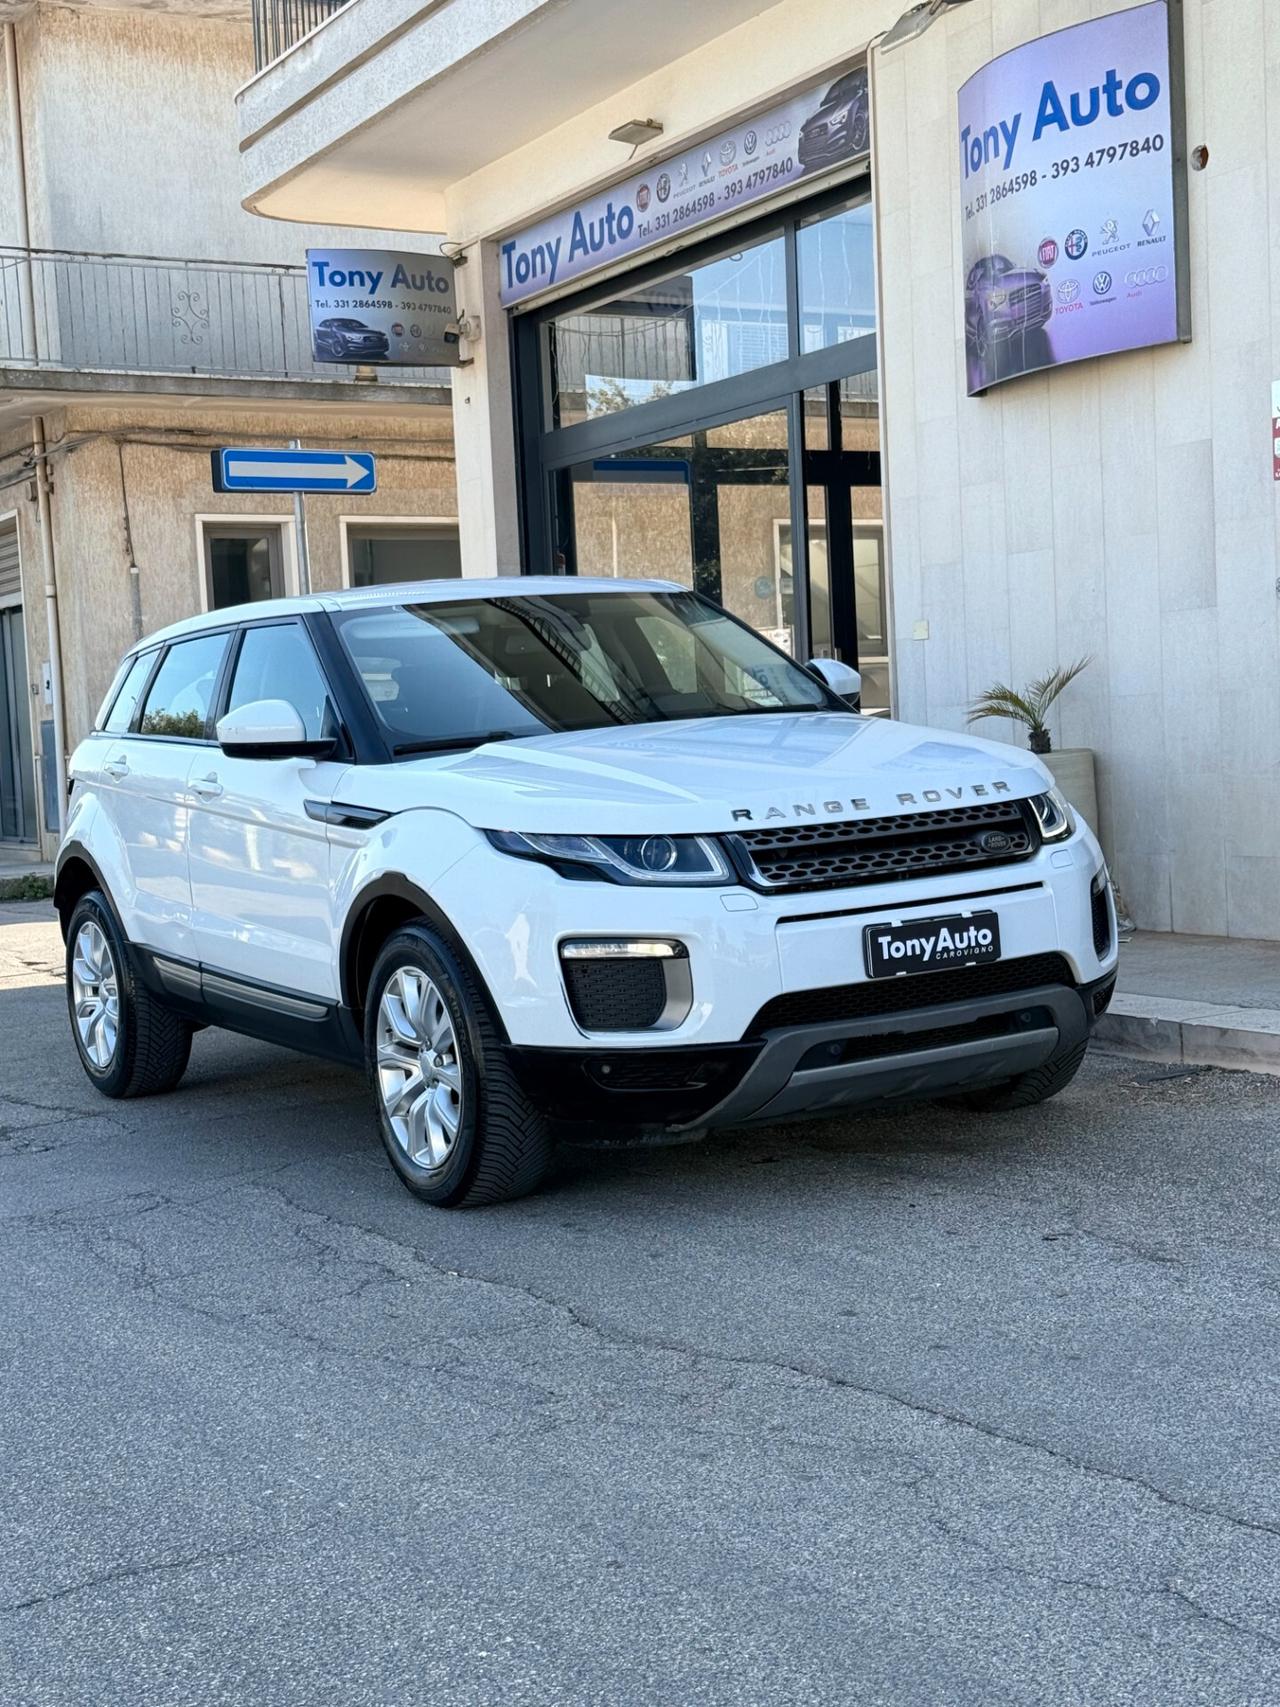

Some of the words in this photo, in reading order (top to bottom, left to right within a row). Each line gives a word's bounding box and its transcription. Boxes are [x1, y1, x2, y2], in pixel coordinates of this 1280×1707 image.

[961, 112, 1022, 179] Tony
[1032, 69, 1161, 142] Auto
[965, 203, 975, 221] Tel.
[976, 192, 988, 214] 331
[990, 170, 1038, 205] 2864598
[1051, 156, 1080, 180] 393
[1084, 134, 1164, 169] 4797840
[638, 221, 653, 239] Tel.
[655, 212, 670, 231] 331
[672, 192, 715, 224] 2864598
[724, 180, 743, 201] 393
[745, 157, 793, 190] 4797840
[502, 236, 562, 288] Tony
[568, 202, 634, 263] Auto
[1091, 243, 1131, 257] PEUGEOT
[1137, 235, 1167, 247] RENAULT
[312, 261, 384, 295] Tony
[390, 263, 450, 294] Auto
[315, 300, 331, 309] Tel.
[334, 300, 350, 309] 331
[352, 300, 393, 309] 2864598
[401, 301, 417, 311] 393
[1055, 302, 1084, 315] TOYOTA
[731, 798, 871, 822] RANGE
[896, 780, 1011, 806] ROVER
[878, 926, 993, 961] TonyAuto
[936, 945, 994, 960] CAROVIGNO
